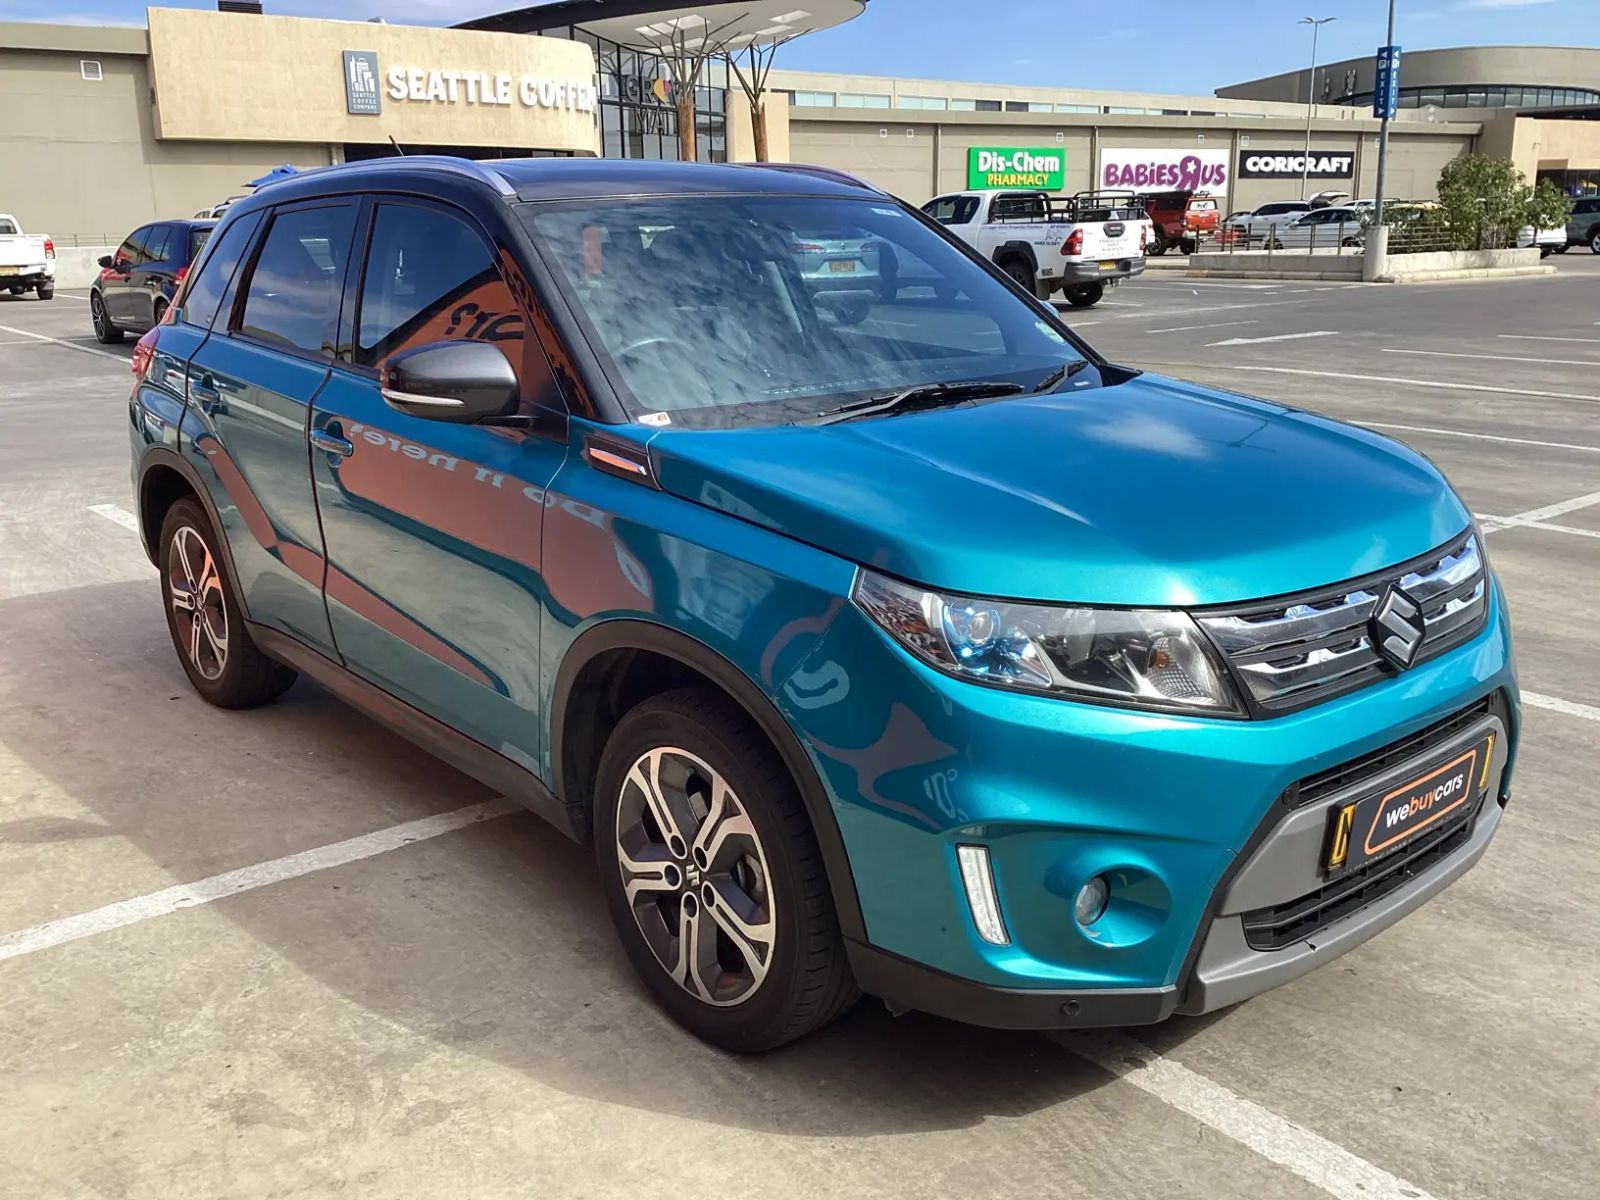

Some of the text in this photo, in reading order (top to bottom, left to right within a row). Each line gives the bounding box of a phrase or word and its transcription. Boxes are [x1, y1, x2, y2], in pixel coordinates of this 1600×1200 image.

[387, 66, 512, 107] SEATTLE
[1379, 71, 1387, 105] EXIT
[978, 151, 1060, 173] Dis-Chem
[1245, 155, 1352, 173] CORICRAFT
[987, 173, 1049, 186] PHARMACY
[1385, 772, 1464, 829] webuycars
